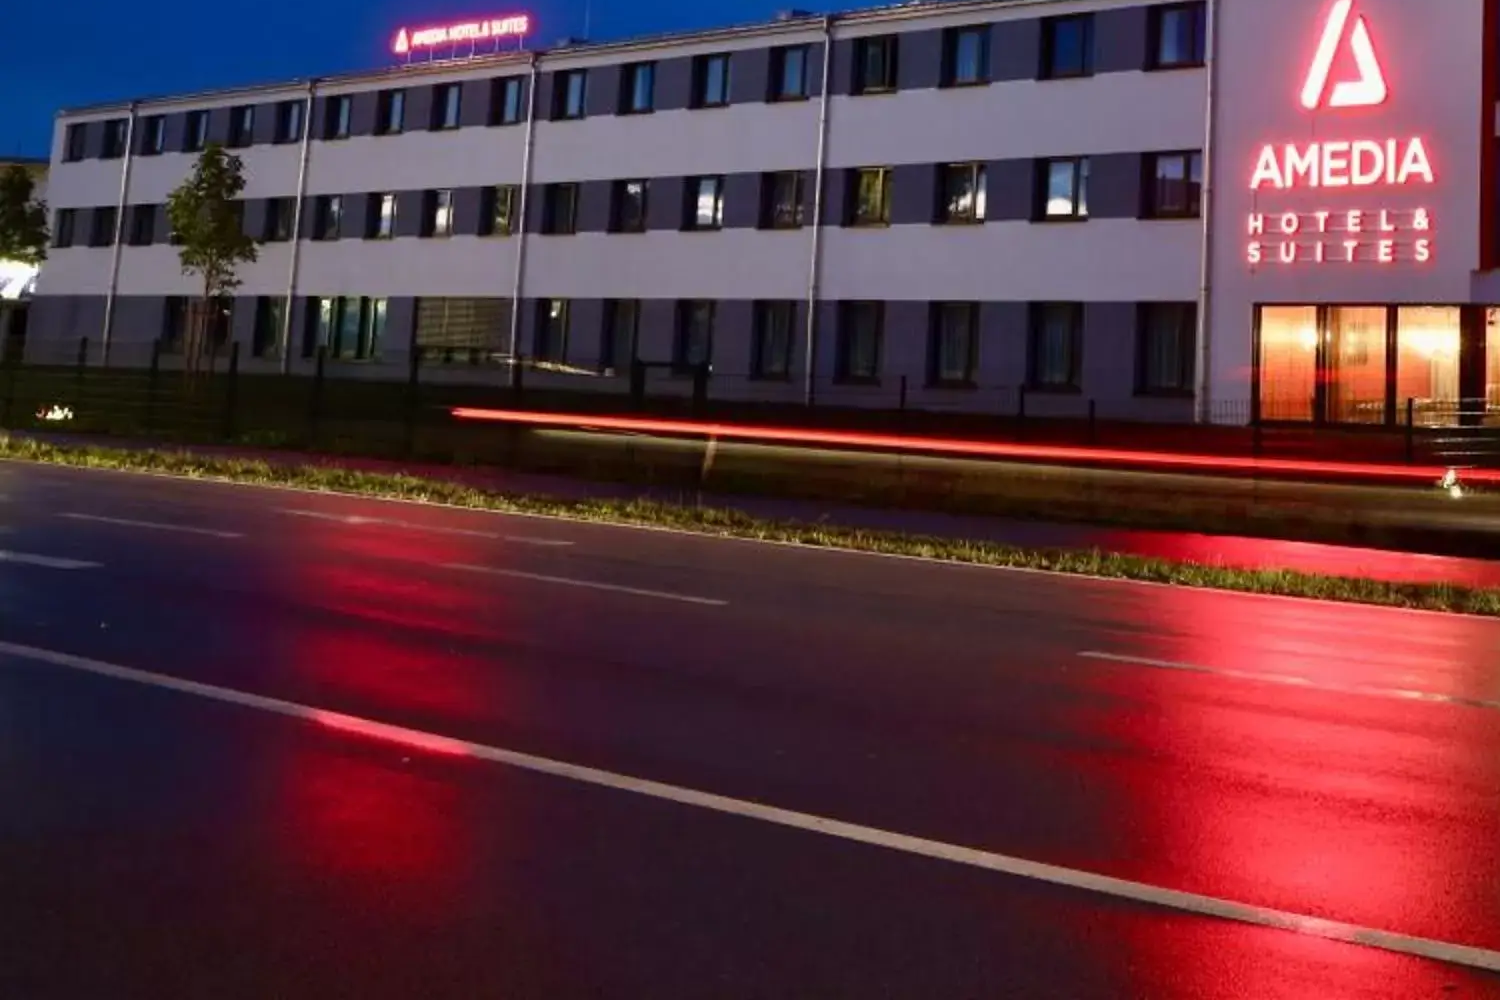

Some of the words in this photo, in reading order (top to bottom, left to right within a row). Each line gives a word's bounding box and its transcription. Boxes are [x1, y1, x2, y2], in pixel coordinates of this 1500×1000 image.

[1249, 137, 1433, 189] AMEDIA
[1248, 209, 1395, 235] HOTEL
[1247, 239, 1430, 263] SUITES
